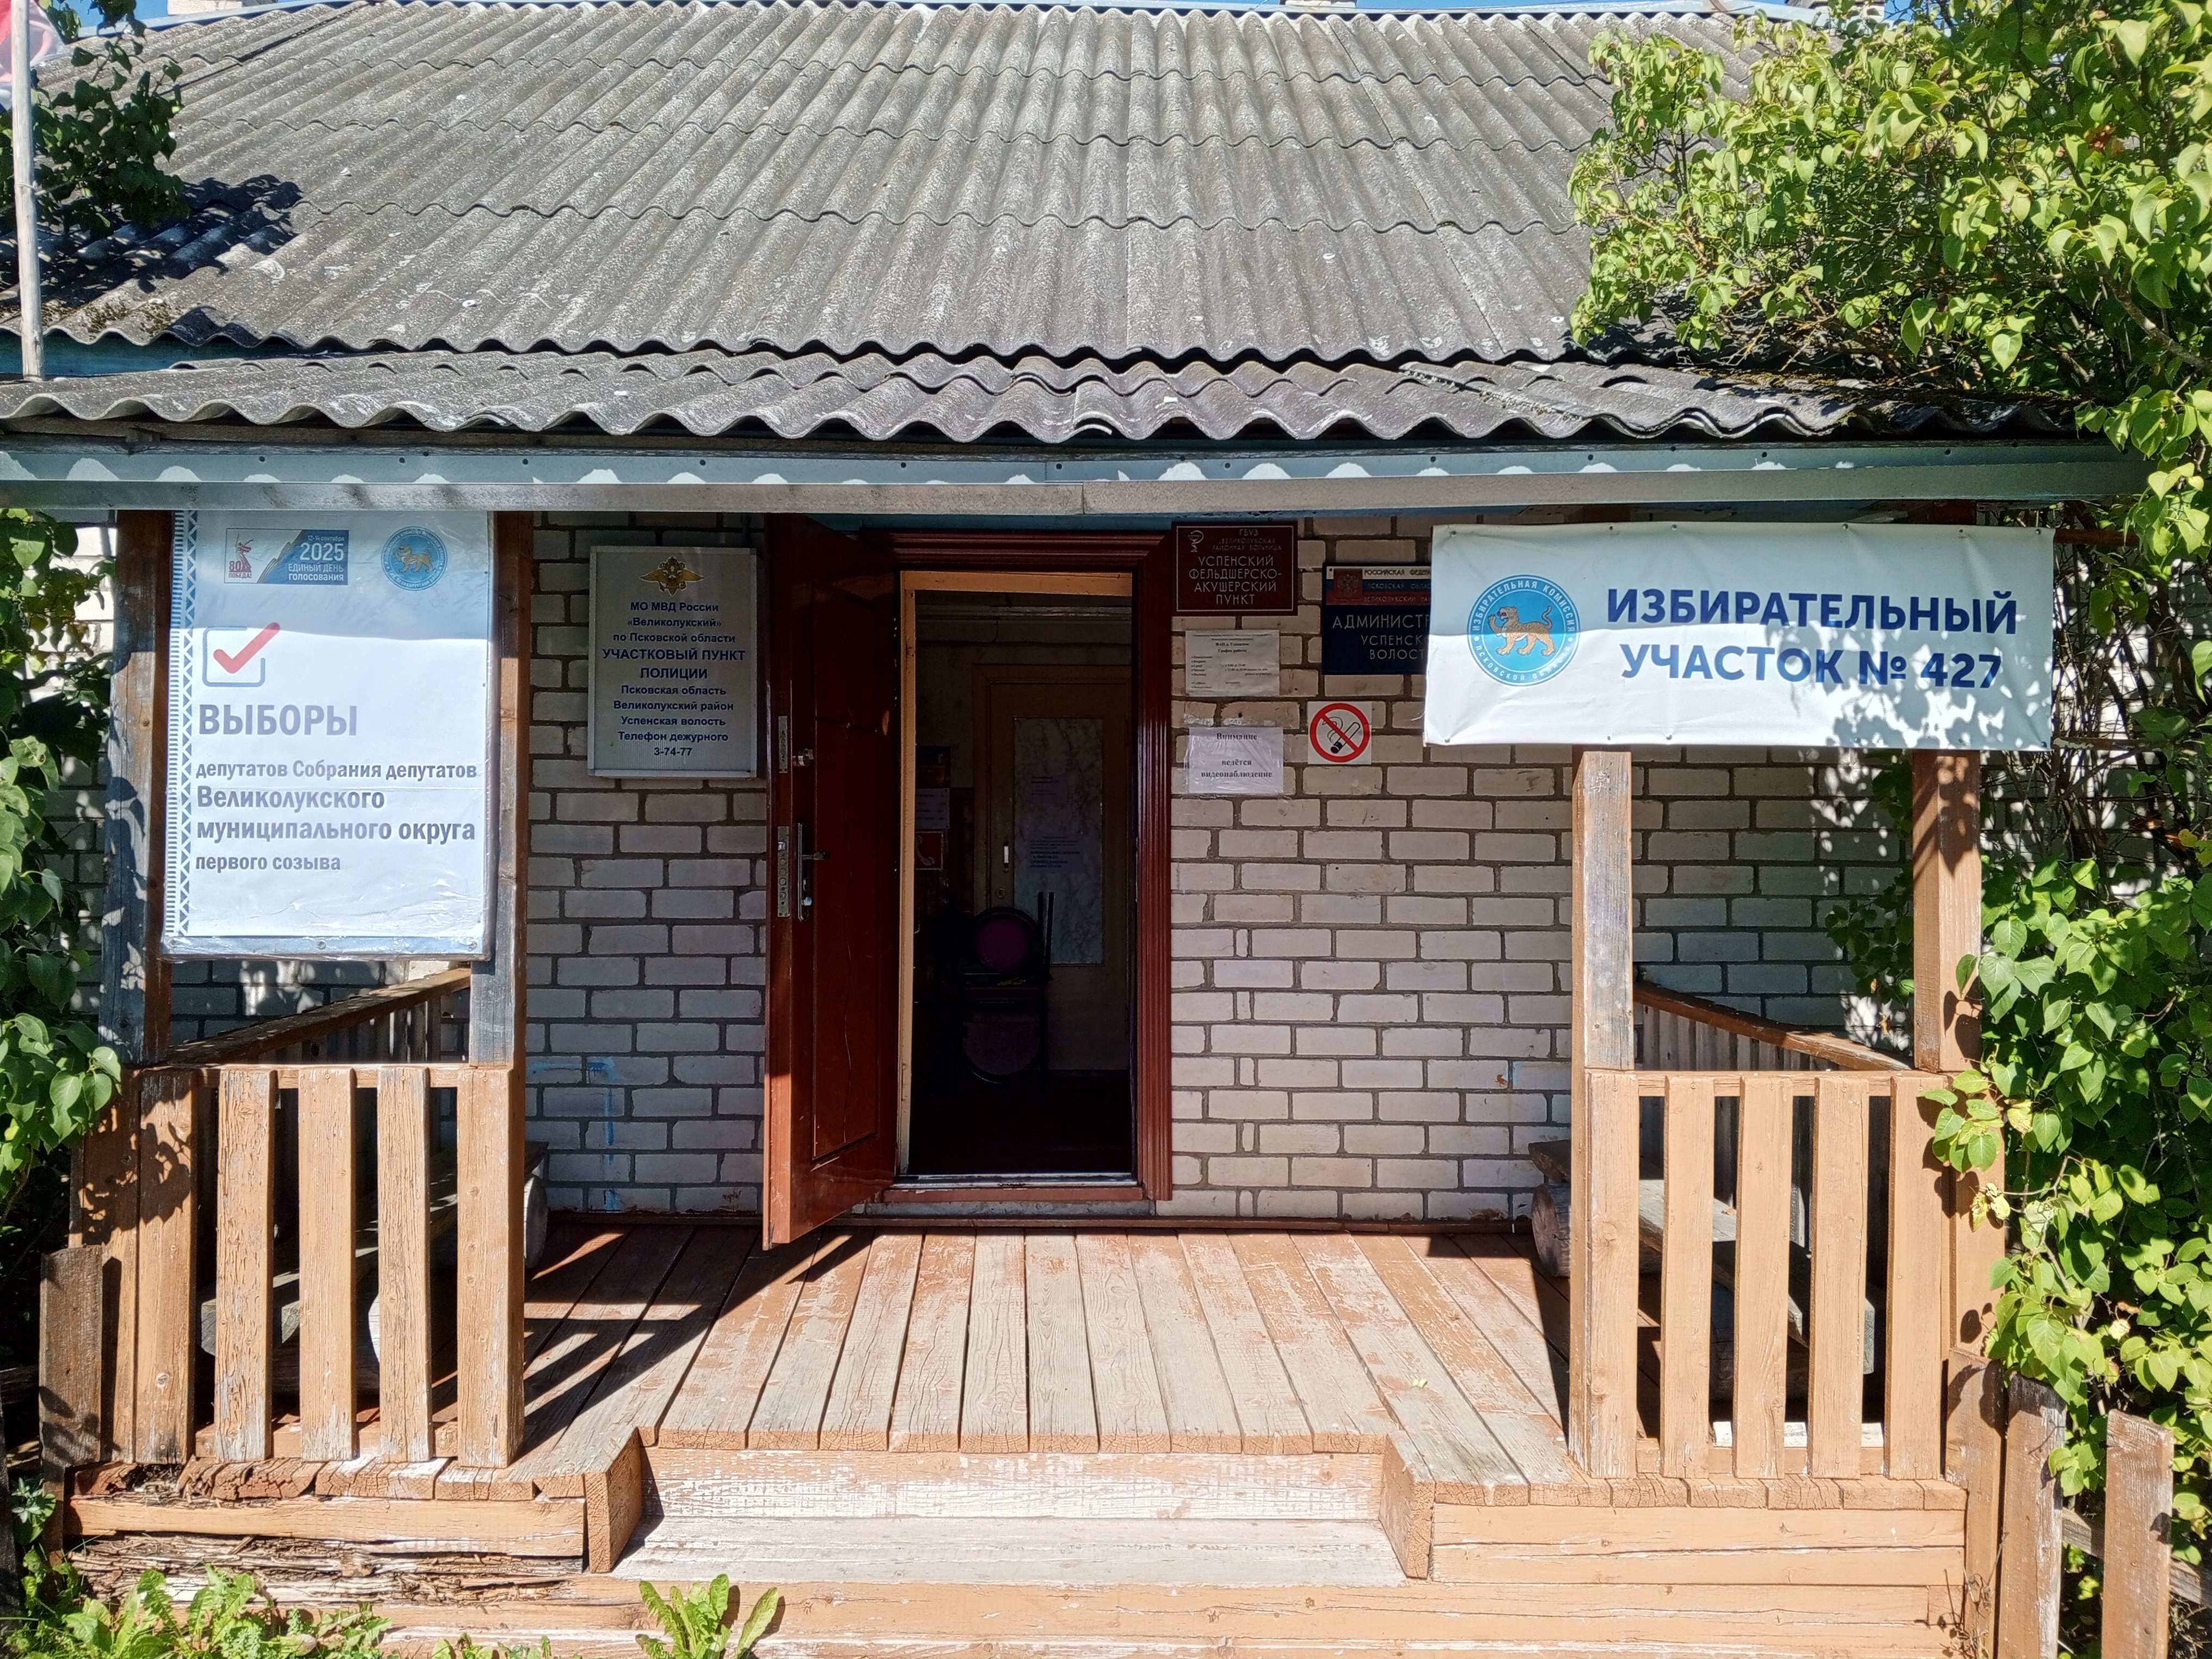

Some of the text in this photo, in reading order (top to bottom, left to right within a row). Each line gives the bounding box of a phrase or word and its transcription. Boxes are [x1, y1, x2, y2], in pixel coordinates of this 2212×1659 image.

[299, 543, 343, 561] 2025
[229, 561, 242, 572] 80
[1198, 555, 1274, 567] УСПЕНСКИЙ
[288, 563, 343, 573] ЕДИНЫЙ ДЕНЬ
[1189, 569, 1282, 580] ФЕЛЬДШЕРСКО-
[1194, 580, 1276, 592] АКУШЕРСКИЙ
[1216, 594, 1255, 605] ПУНКТ
[630, 602, 718, 612] МО МВД России
[1472, 580, 1575, 632] ИЗБИРАТЕЛЬНАЯ КОМИССИЯ
[1608, 588, 2017, 635] ИЗБИРАТЕЛЬНЫЙ
[627, 617, 722, 628] «Великолукский»
[630, 633, 687, 642] Псковской
[691, 634, 735, 642] области
[602, 648, 746, 661] УЧАСТКОВЫЙ ПУНКТ
[1475, 645, 1571, 681] ПСКОВСКОЙ ОБЛАСТИ
[1619, 644, 2001, 689] УЧАСТОК № 427
[640, 667, 708, 680] ПОЛИЦИИ
[621, 685, 727, 695] Псковская область
[613, 700, 734, 712] Великолукский район
[199, 704, 357, 736] ВЫБОРЫ
[621, 716, 726, 726] Успенская волость
[618, 731, 728, 742] Телефон дежурного
[654, 747, 692, 756] 3-74-77
[196, 760, 477, 782] депутатов Собрания депутатов
[197, 785, 385, 813] Великолукского
[196, 821, 475, 844] муниципального округа
[196, 856, 341, 872] первого созыва
